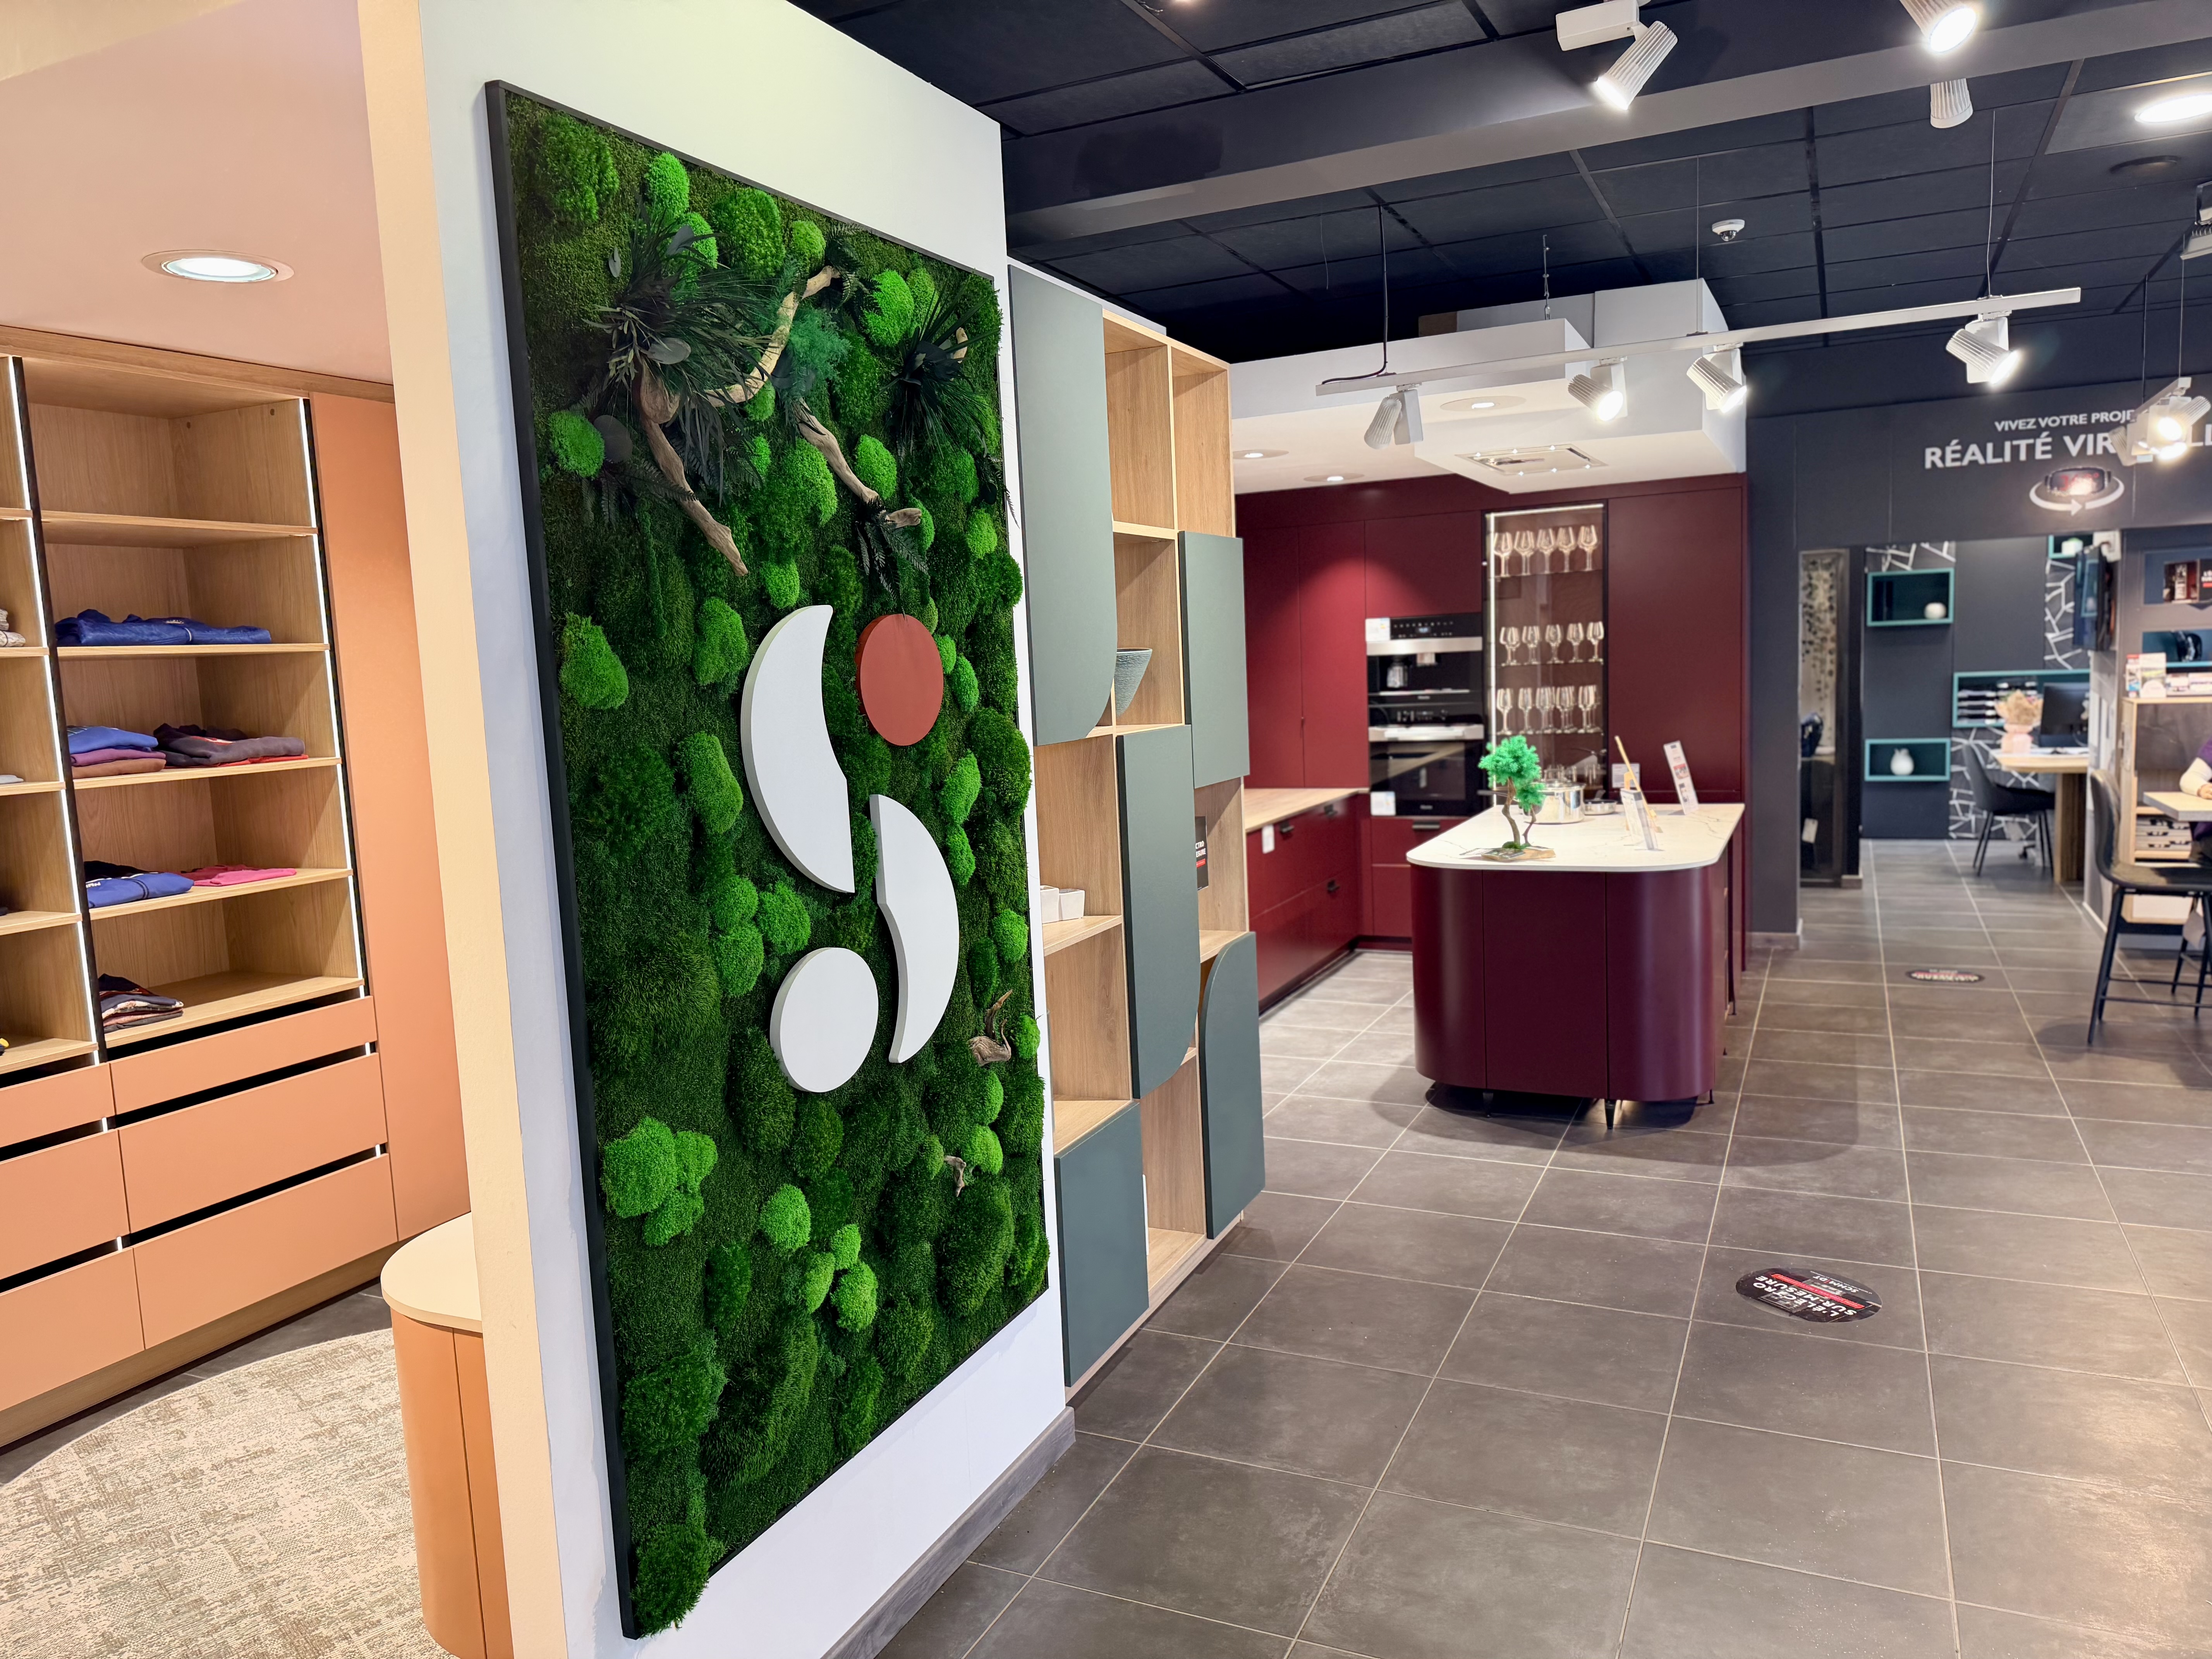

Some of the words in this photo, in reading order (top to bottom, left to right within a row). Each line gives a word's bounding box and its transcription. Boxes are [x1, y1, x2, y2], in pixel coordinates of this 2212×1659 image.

[1995, 418, 2036, 432] VIVEZ
[2039, 413, 2087, 428] VOTRE
[2092, 409, 2135, 424] PROJE
[1925, 431, 2052, 469] RÉALITÉ
[1753, 1282, 1839, 1316] L'ÉLECTRO
[1755, 1276, 1857, 1315] SUR-MESURE
[1812, 1275, 1859, 1293] SCHMIDT
